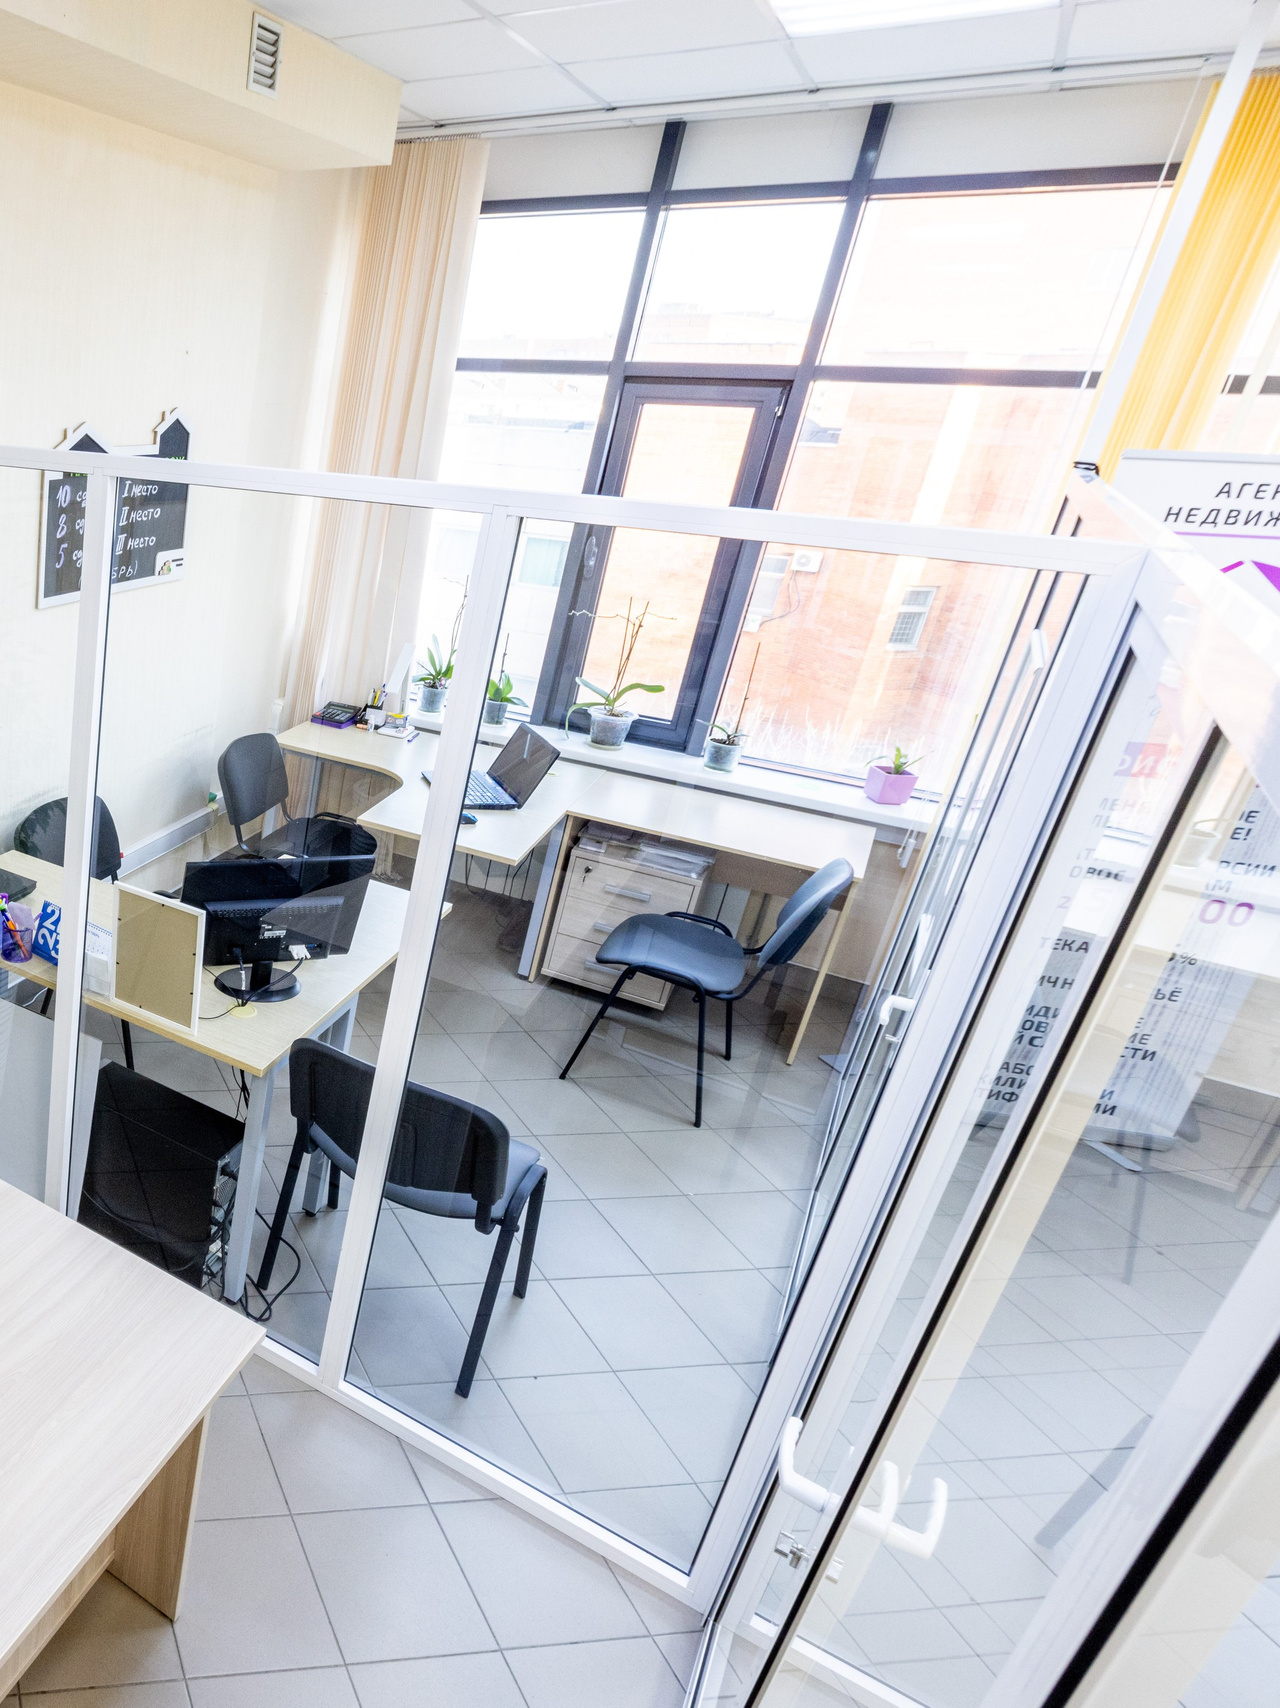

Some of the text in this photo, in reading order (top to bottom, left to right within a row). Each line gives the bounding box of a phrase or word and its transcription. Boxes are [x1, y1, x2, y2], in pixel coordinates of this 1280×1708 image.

[56, 485, 71, 508] 10
[131, 485, 158, 497] место
[56, 513, 67, 538] 8
[130, 507, 161, 522] место
[56, 543, 68, 569] 5
[127, 536, 156, 551] место
